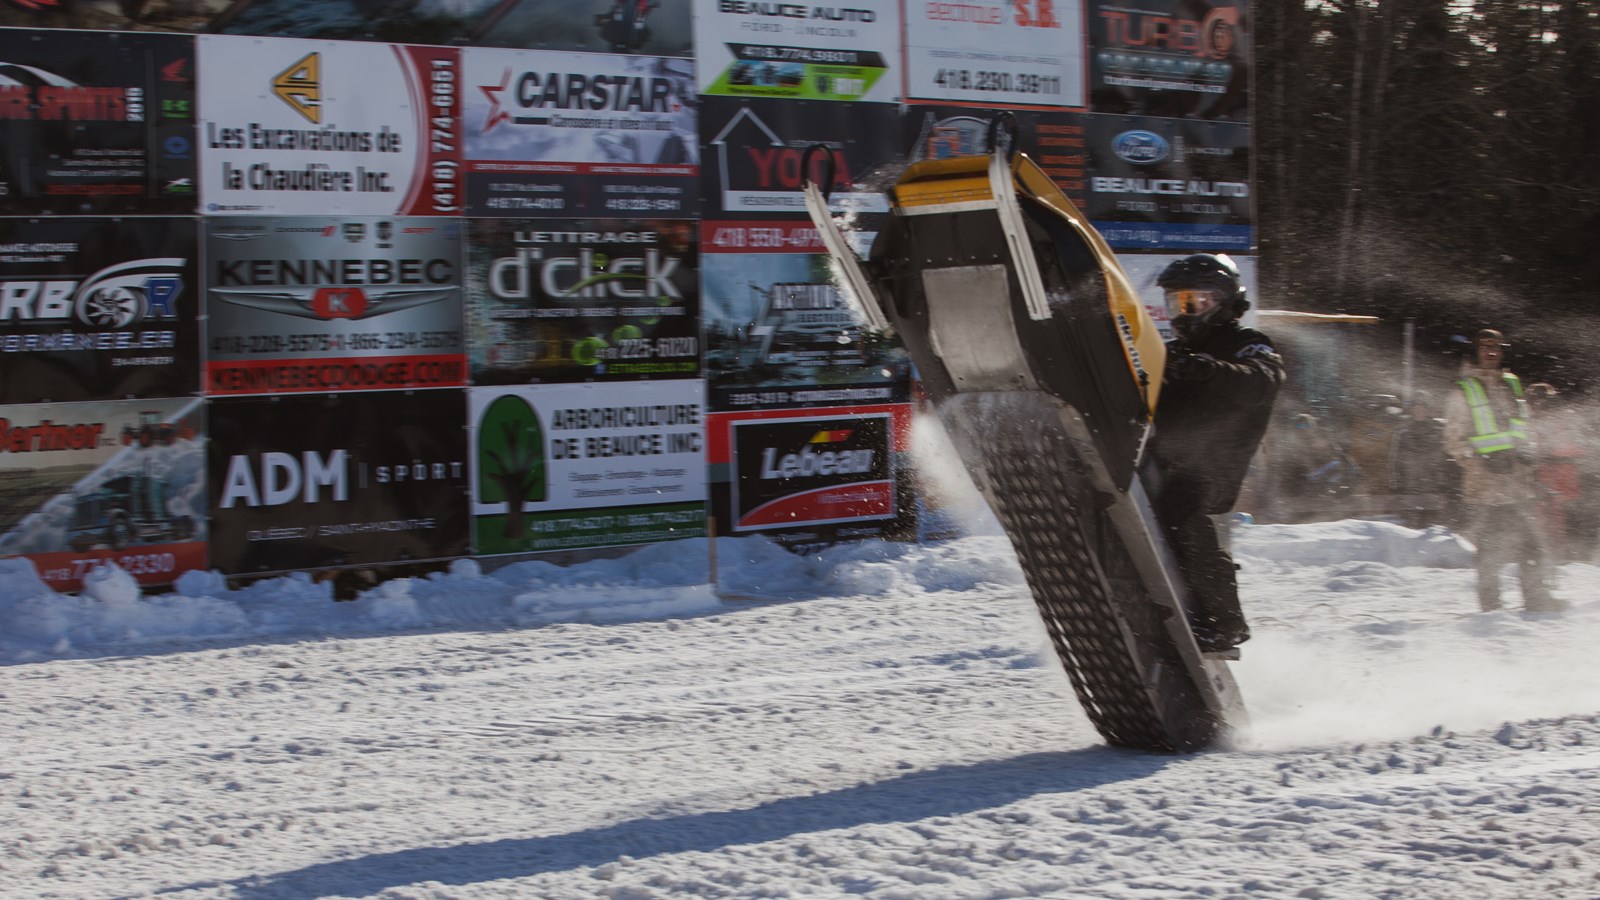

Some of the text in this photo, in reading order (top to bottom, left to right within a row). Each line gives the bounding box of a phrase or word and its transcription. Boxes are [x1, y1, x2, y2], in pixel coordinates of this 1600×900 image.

[718, 0, 876, 23] BEAUCE AUTO
[741, 21, 785, 33] FORD
[795, 24, 858, 37] LINCOLN
[517, 71, 671, 112] CARSTAR
[933, 68, 1060, 95] 418.230.3911
[206, 122, 402, 152] Les Excavations de
[222, 161, 395, 193] la Chaudière Inc.
[430, 160, 459, 212] (418)
[1092, 177, 1186, 195] BEAUCE
[1187, 180, 1249, 197] AUTO
[1116, 201, 1158, 212] FORD
[1170, 203, 1231, 214] LINCOLN
[514, 231, 657, 243] LETTRAGE
[712, 228, 828, 247] 418 558-499
[216, 258, 453, 286] KENNEBEC
[327, 293, 350, 313] K
[212, 331, 462, 353] 418-228-5575 1-866-234-5575
[617, 337, 698, 358] 225-6020
[213, 361, 464, 391] KENNEBECDODGE.COM
[551, 404, 701, 430] ARBORICULTURE
[551, 432, 702, 460] DE BEAUCE INC
[760, 445, 873, 480] Lebeau
[219, 449, 463, 509] ADM SPORT
[120, 552, 175, 575] 2330
